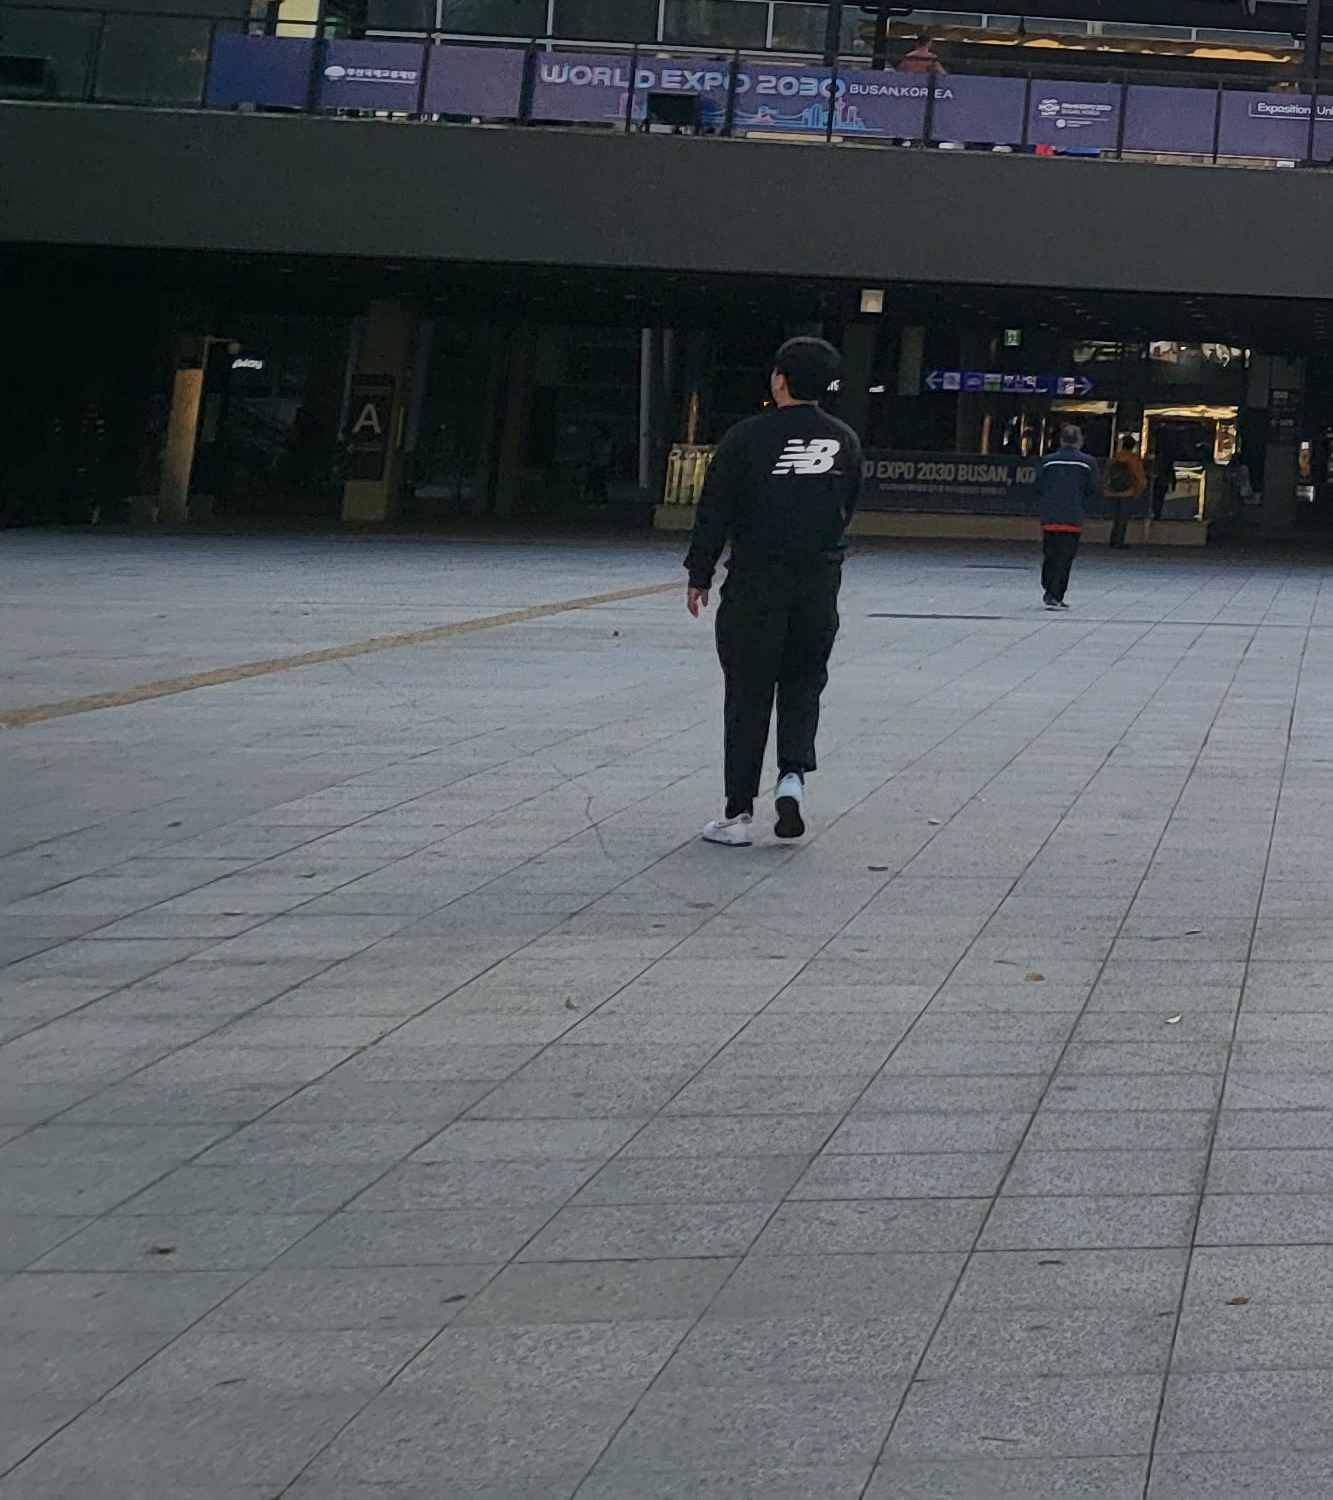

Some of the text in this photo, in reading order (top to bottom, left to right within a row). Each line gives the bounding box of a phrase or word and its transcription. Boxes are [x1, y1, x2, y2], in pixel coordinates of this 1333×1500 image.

[540, 63, 656, 89] WORLD
[661, 68, 751, 93] EXPO
[755, 74, 846, 98] 2030
[1257, 102, 1312, 115] Exposition
[351, 403, 382, 435] A
[771, 438, 842, 475] NB
[877, 461, 915, 479] EXPO
[917, 462, 955, 481] 2030
